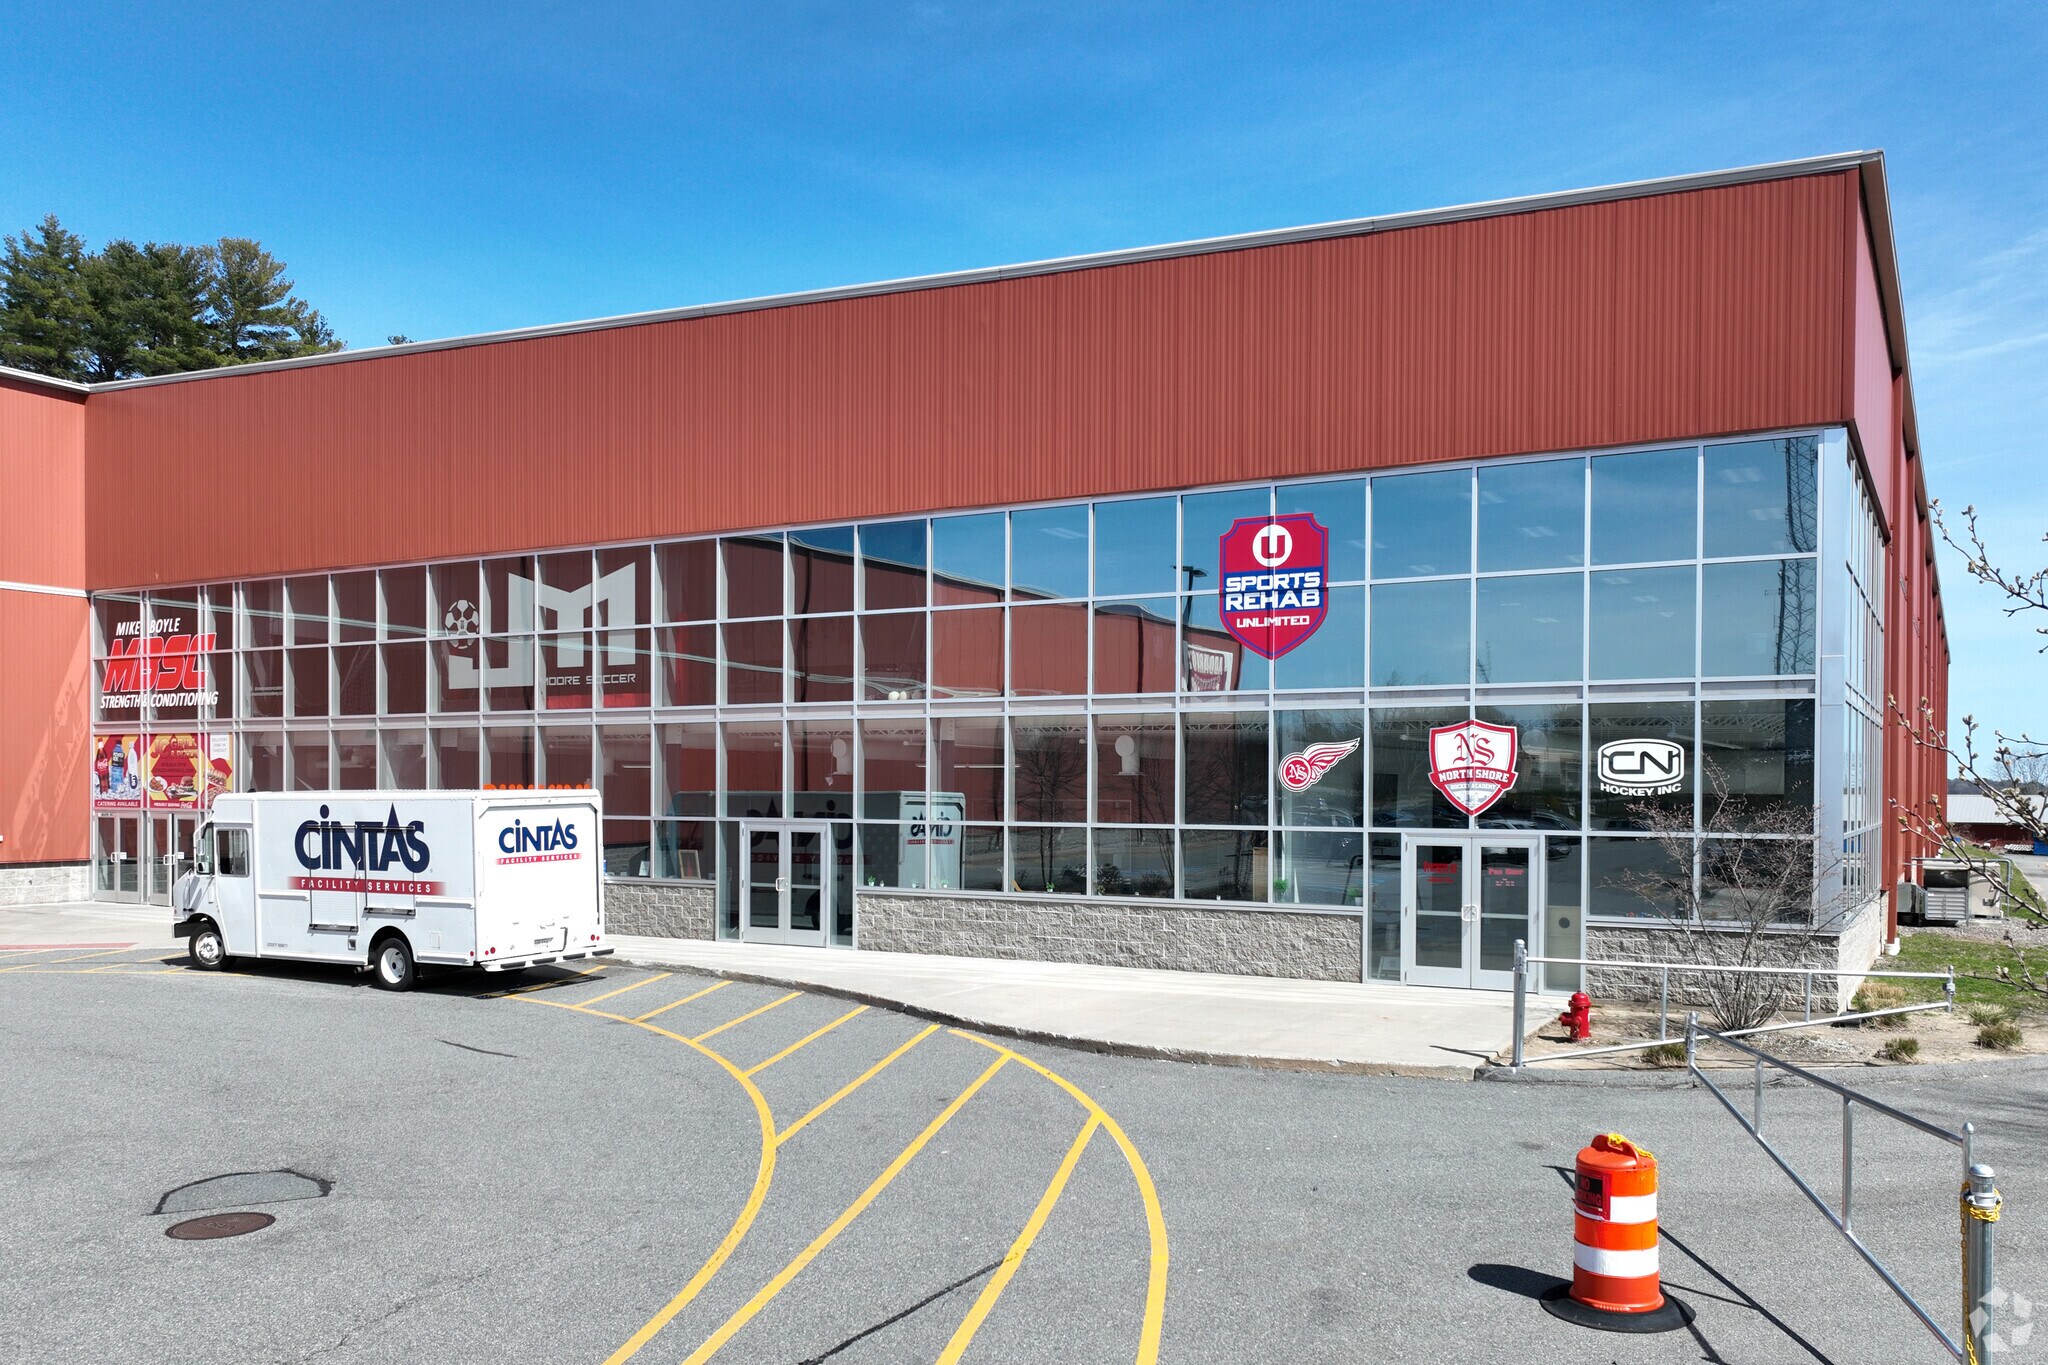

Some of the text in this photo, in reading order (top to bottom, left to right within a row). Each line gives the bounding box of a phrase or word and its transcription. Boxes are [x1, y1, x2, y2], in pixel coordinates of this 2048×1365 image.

[1225, 571, 1321, 593] SPORTS
[1225, 589, 1320, 611] REHAB
[115, 617, 181, 636] MIKE BOYLE
[1236, 615, 1310, 628] UNLIMITED
[101, 632, 218, 693] MBSC
[585, 673, 636, 685] SOCCER
[100, 694, 141, 709] STRENGTH
[149, 691, 219, 708] CONDITIONING
[1453, 732, 1495, 766] NS
[1608, 750, 1674, 775] CN
[1438, 769, 1510, 783] NORTH SHORE
[1600, 782, 1682, 797] HOCKEY INC
[294, 802, 431, 874] CINTAS
[498, 816, 578, 854] CINTAS
[500, 853, 578, 864] FACILITY SERVICES
[301, 879, 431, 893] FACILITY SERVICES
